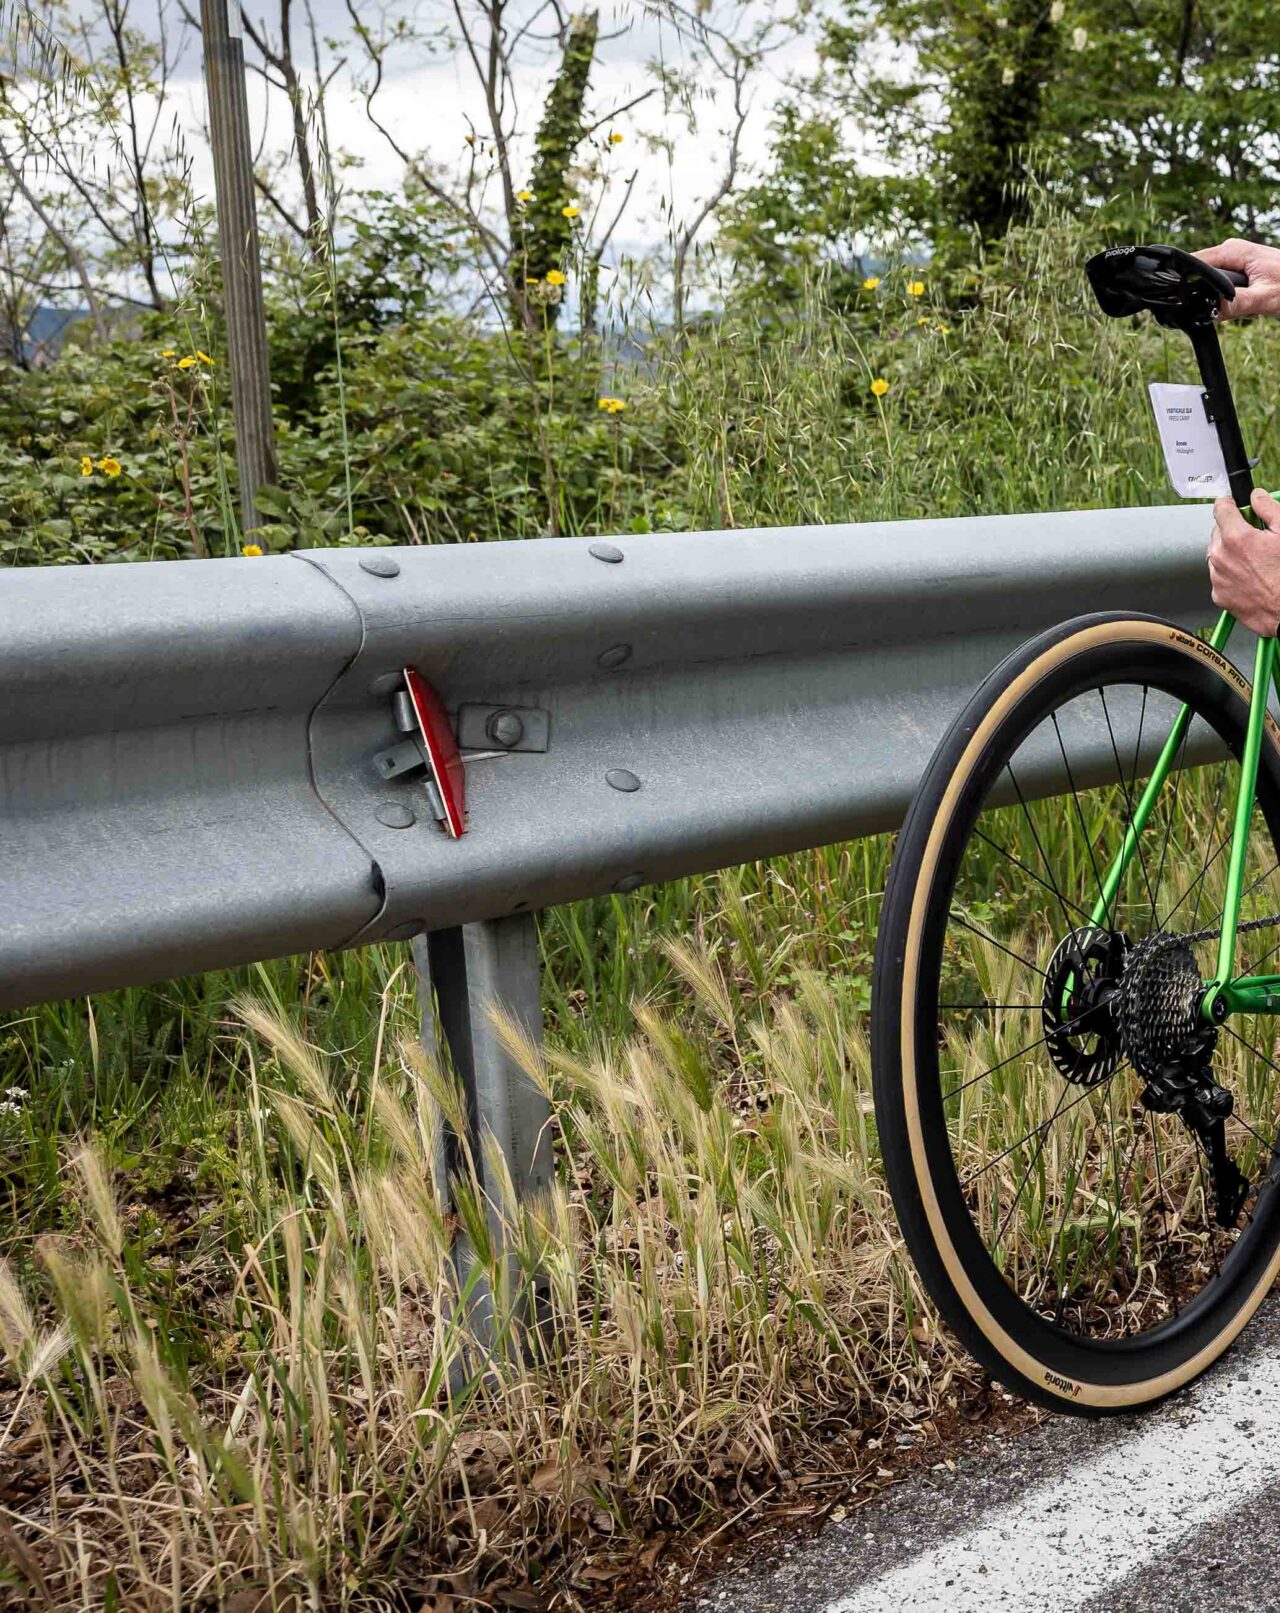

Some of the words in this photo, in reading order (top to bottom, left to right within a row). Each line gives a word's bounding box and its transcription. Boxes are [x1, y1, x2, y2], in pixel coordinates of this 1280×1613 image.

[1105, 246, 1136, 259] prologo
[1175, 634, 1195, 648] vittoria
[1196, 643, 1227, 669] CORSA
[1228, 668, 1245, 687] PRO
[1045, 1371, 1076, 1394] vittoria
